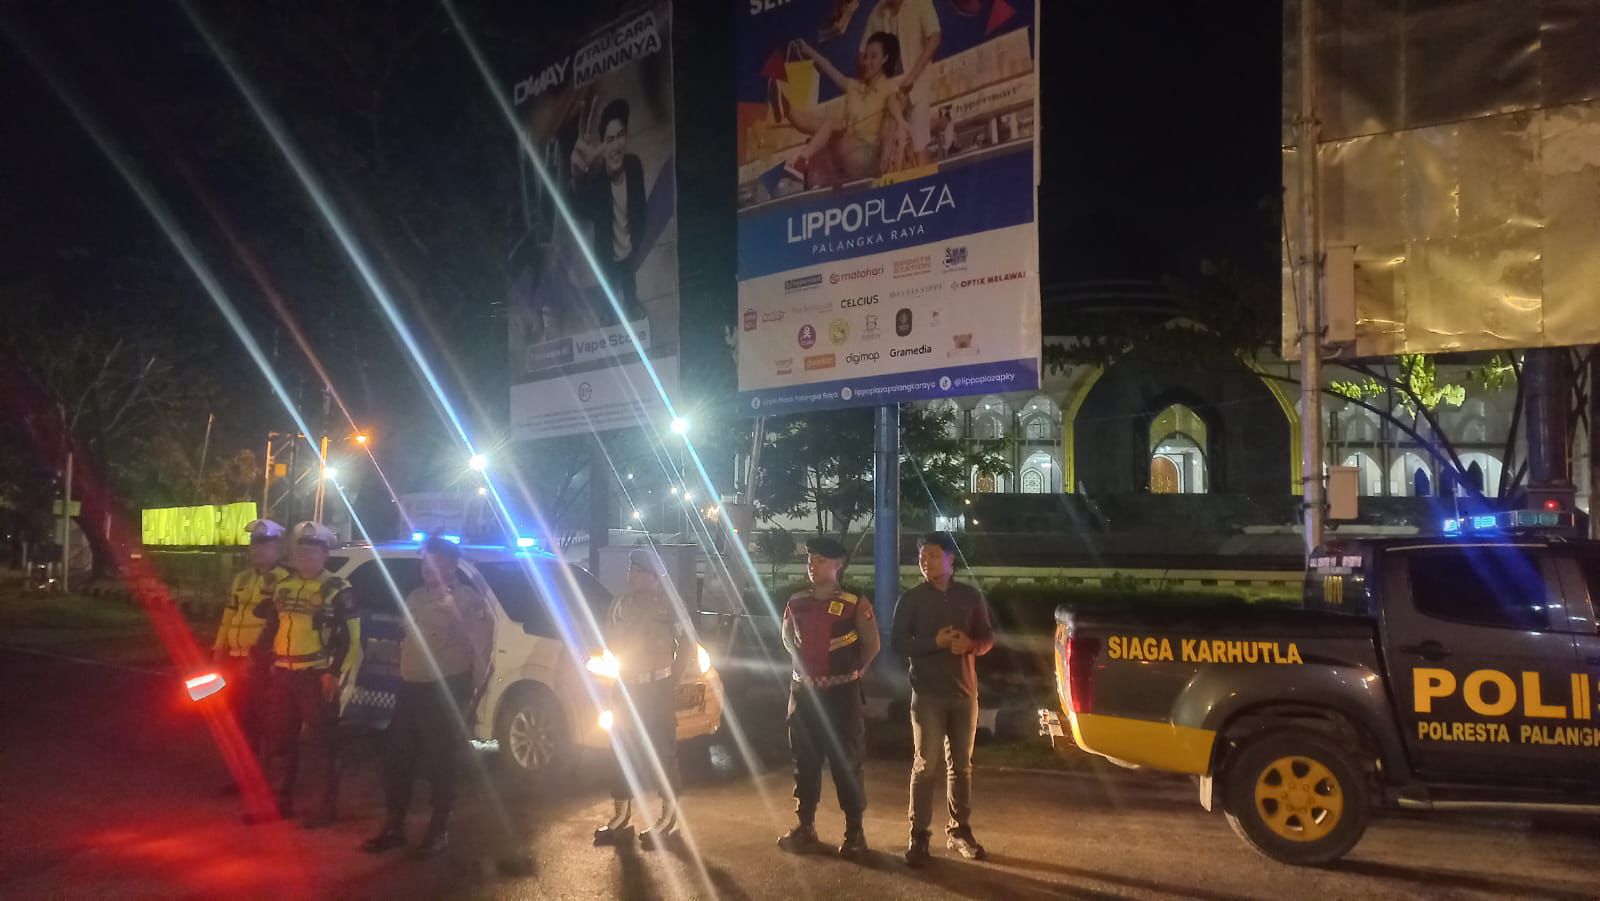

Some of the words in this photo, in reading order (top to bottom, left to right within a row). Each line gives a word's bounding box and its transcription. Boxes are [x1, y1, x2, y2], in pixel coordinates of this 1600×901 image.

[614, 16, 654, 46] CARA
[576, 34, 658, 84] MAINNYA
[812, 233, 884, 254] PALANGKA
[890, 225, 925, 240] RAYA
[840, 266, 884, 281] matahari
[960, 277, 985, 288] OPTIK
[987, 271, 1026, 284] MELAWAI
[840, 295, 879, 308] CELCIUS
[576, 339, 607, 354] Vape
[609, 330, 646, 346] Stoe
[889, 344, 932, 357] Gramedia
[846, 351, 880, 364] digimap
[1108, 636, 1173, 661] SIAGA
[1181, 639, 1303, 665] KARHUTLA
[1413, 667, 1600, 720] POLI
[1418, 721, 1510, 743] POLRESTA
